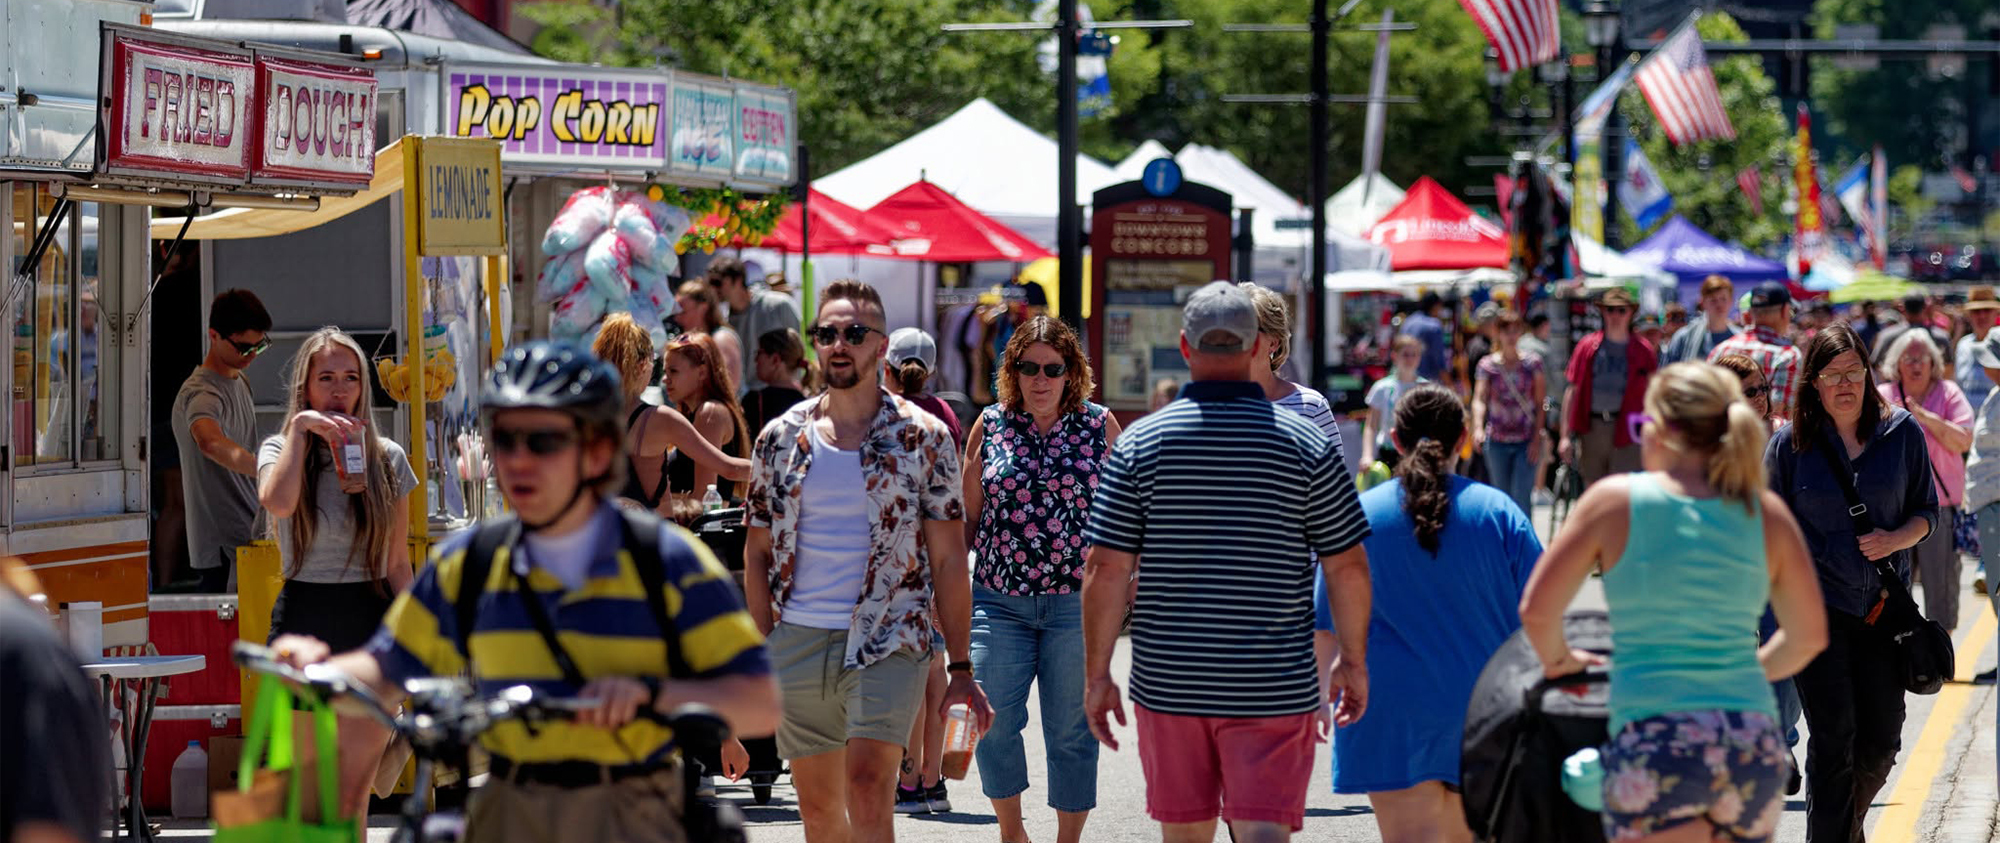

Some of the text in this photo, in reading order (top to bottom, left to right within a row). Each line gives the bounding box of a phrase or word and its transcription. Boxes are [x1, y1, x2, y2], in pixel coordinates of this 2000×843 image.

[141, 67, 368, 159] FRIED DOUGH
[429, 164, 492, 224] LEMONADE
[1110, 237, 1209, 255] CONCORD
[1113, 222, 1207, 238] DOWNTOWN
